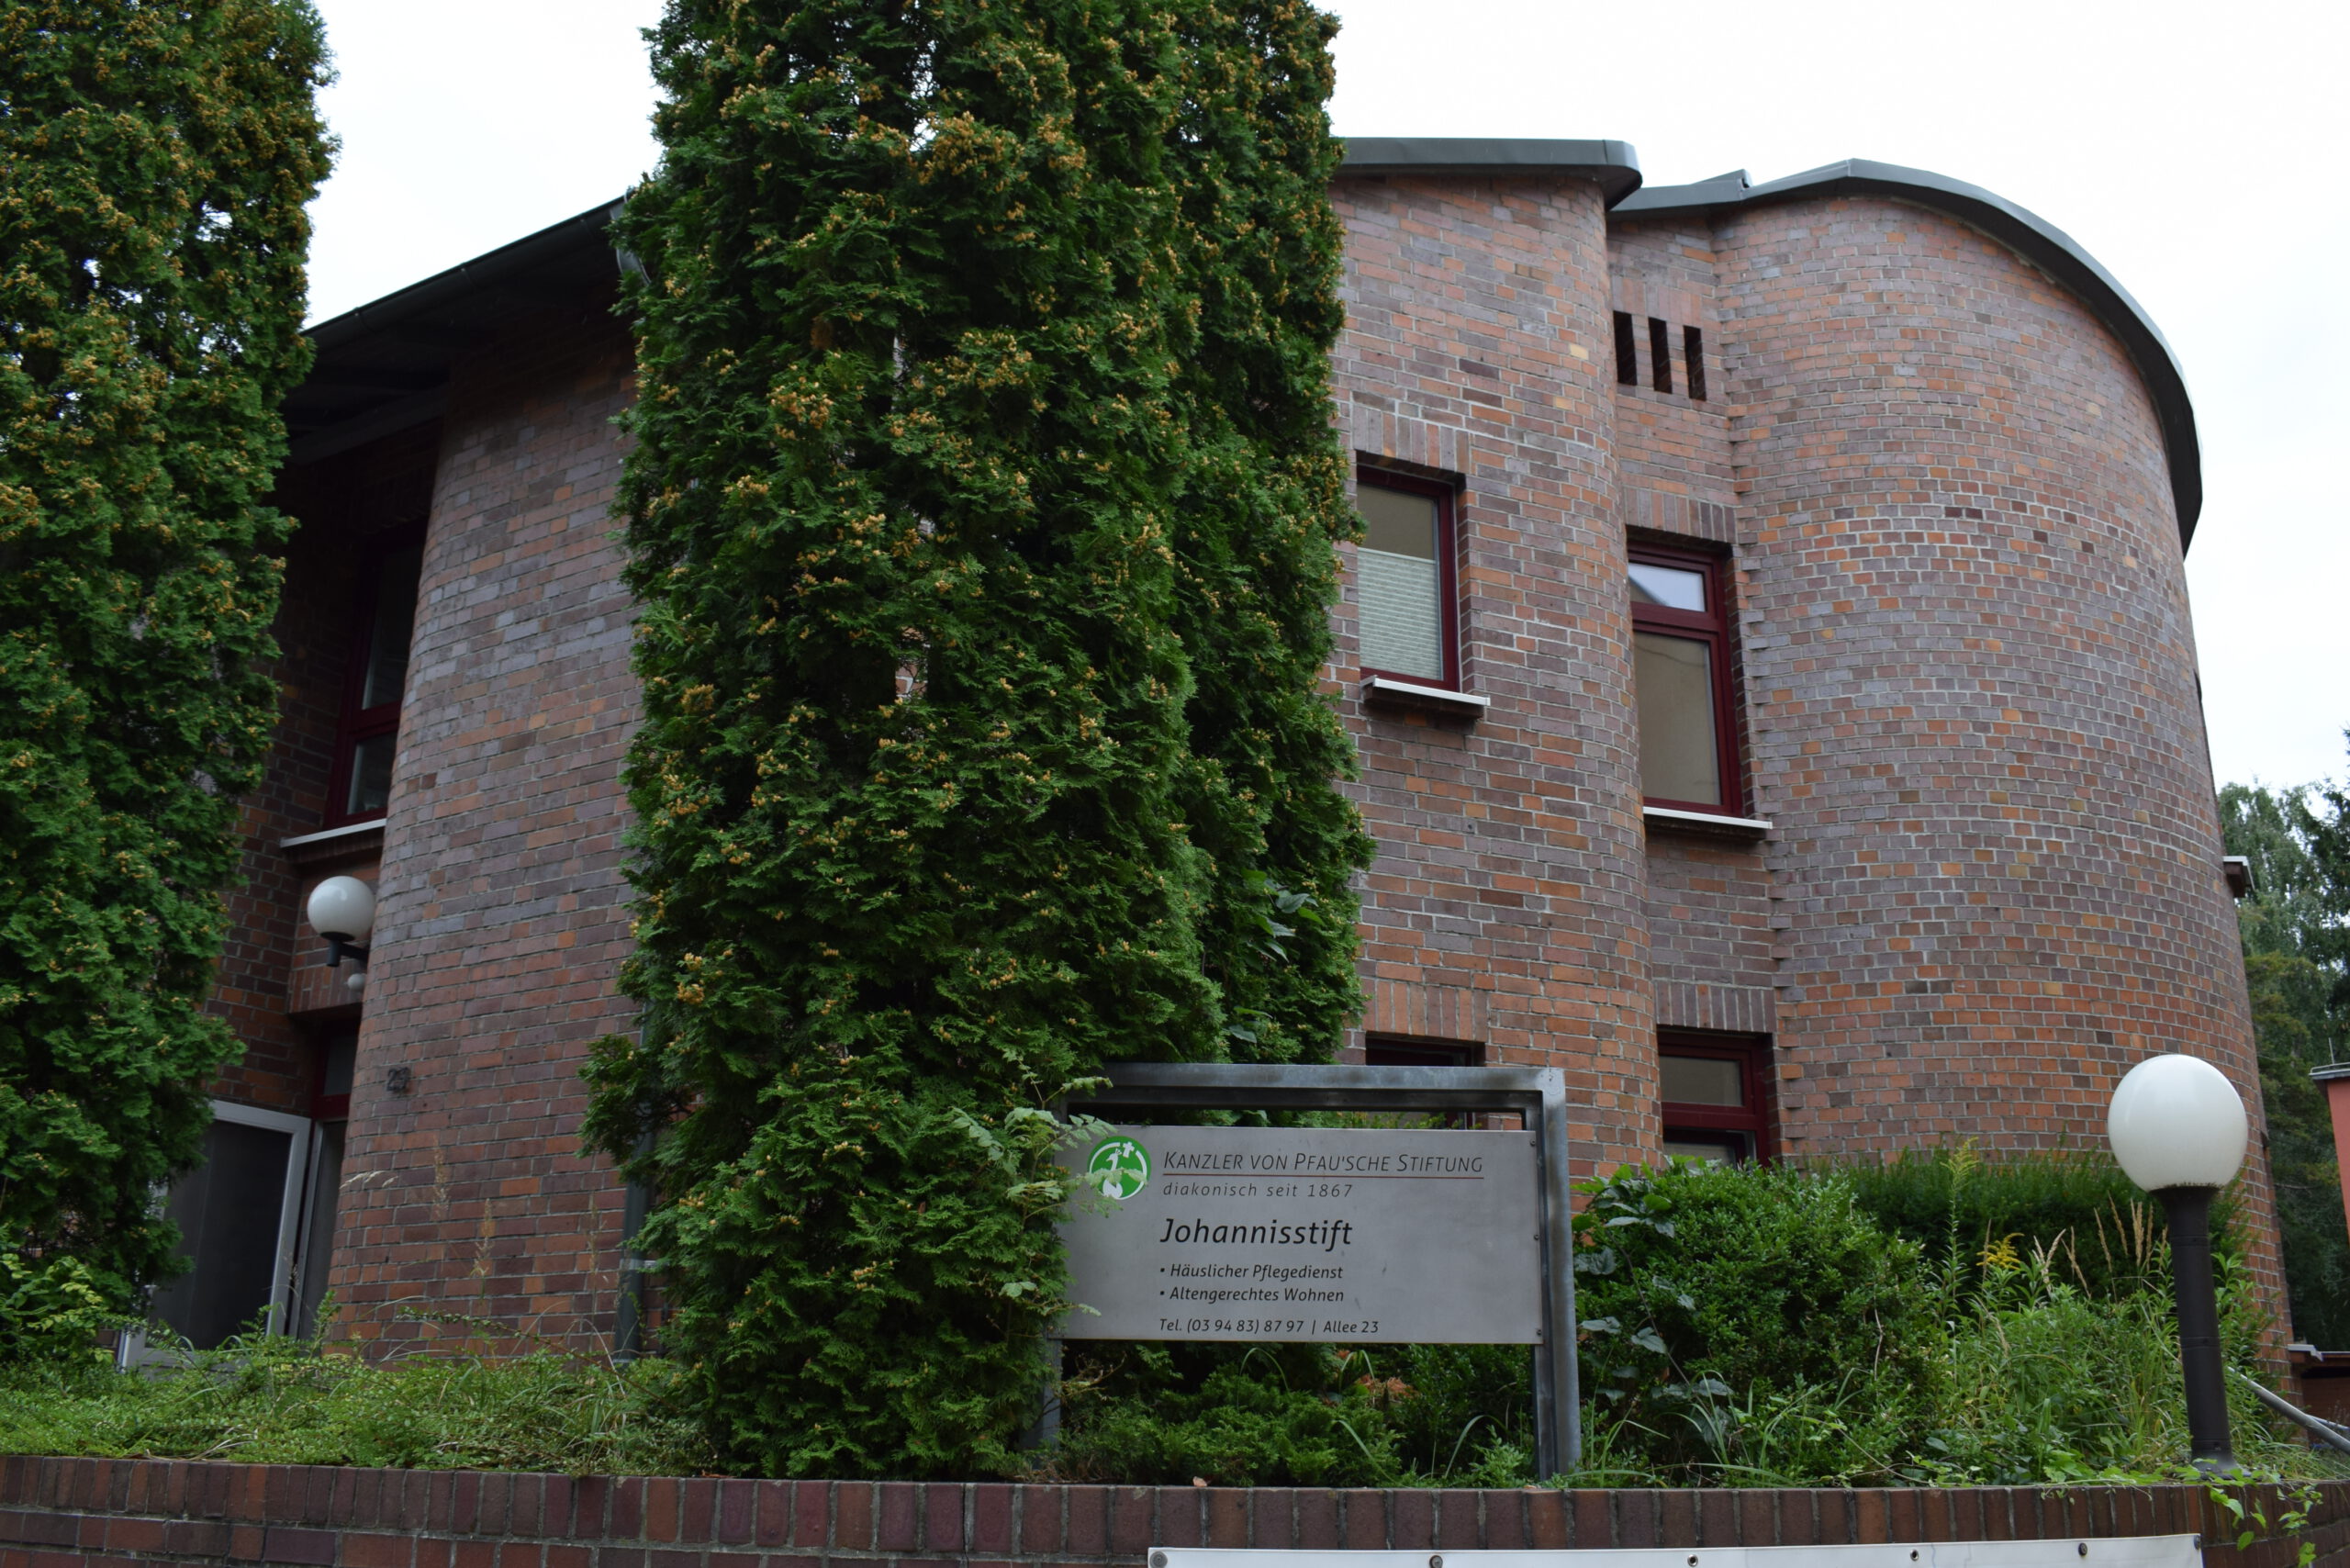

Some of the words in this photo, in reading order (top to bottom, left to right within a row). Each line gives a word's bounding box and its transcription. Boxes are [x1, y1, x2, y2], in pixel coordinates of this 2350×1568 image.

[1163, 1151, 1244, 1170] KANZLER
[1250, 1154, 1288, 1170] VON
[1294, 1152, 1392, 1172] PFAU'SCHE
[1396, 1153, 1483, 1173] STIFTUNG
[1163, 1182, 1258, 1197] diakonisch
[1266, 1183, 1298, 1197] seit
[1307, 1183, 1353, 1198] 1867
[1158, 1217, 1354, 1253] Johannisstift
[1169, 1263, 1249, 1279] Häuslicher
[1252, 1264, 1344, 1282] Pflegedienst
[1169, 1286, 1280, 1305] Altengerechtes
[1284, 1287, 1344, 1303] Wohnen
[1159, 1317, 1183, 1332] Tel.
[1187, 1317, 1211, 1334] (03
[1214, 1318, 1233, 1333] 94
[1236, 1318, 1260, 1335] 83)
[1263, 1319, 1283, 1334] 87
[1286, 1319, 1304, 1334] 97
[1323, 1320, 1358, 1334] Allee
[1360, 1320, 1380, 1334] 23
